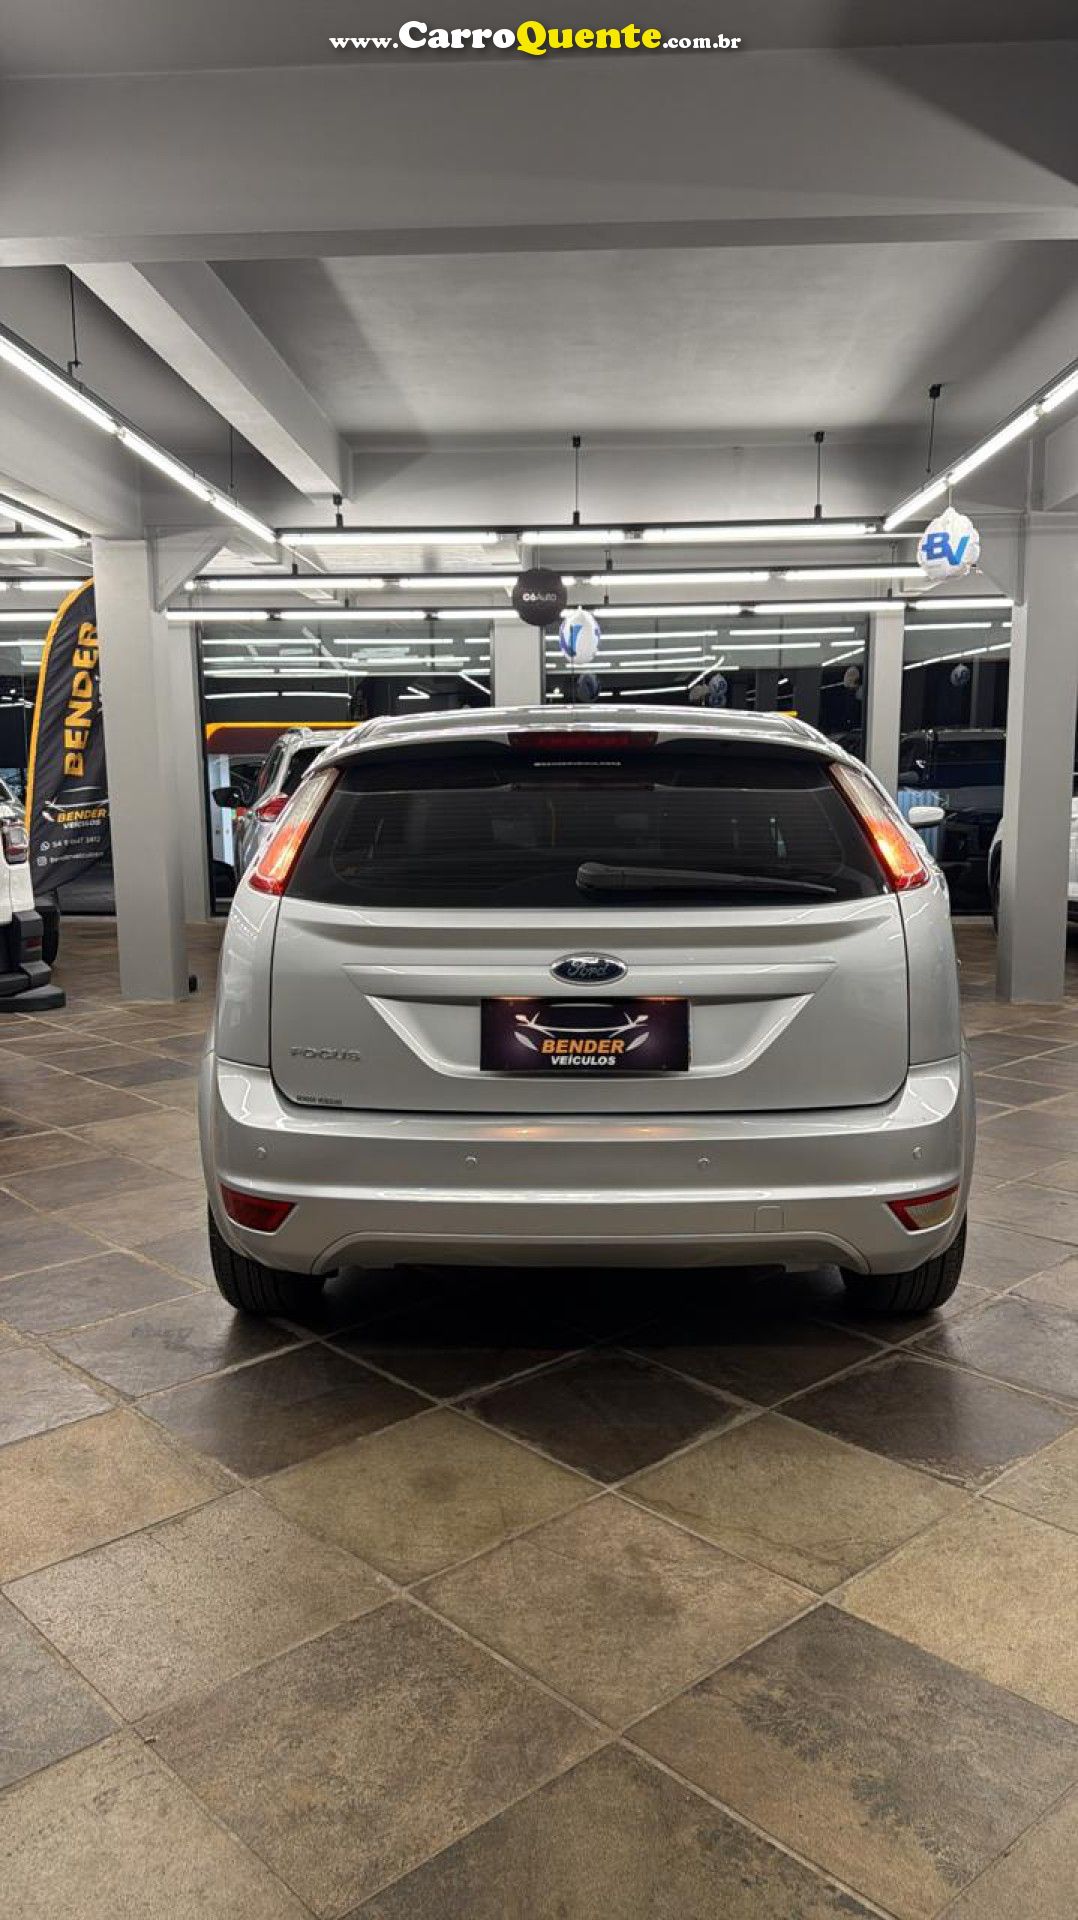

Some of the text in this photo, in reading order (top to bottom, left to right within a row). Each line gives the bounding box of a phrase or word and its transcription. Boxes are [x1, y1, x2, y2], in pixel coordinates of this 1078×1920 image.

[63, 621, 100, 777] BENDER
[567, 960, 610, 978] Ford
[289, 1046, 361, 1061] FOCUS
[541, 1039, 625, 1054] BENDER
[551, 1054, 616, 1066] VEÍCULOS
